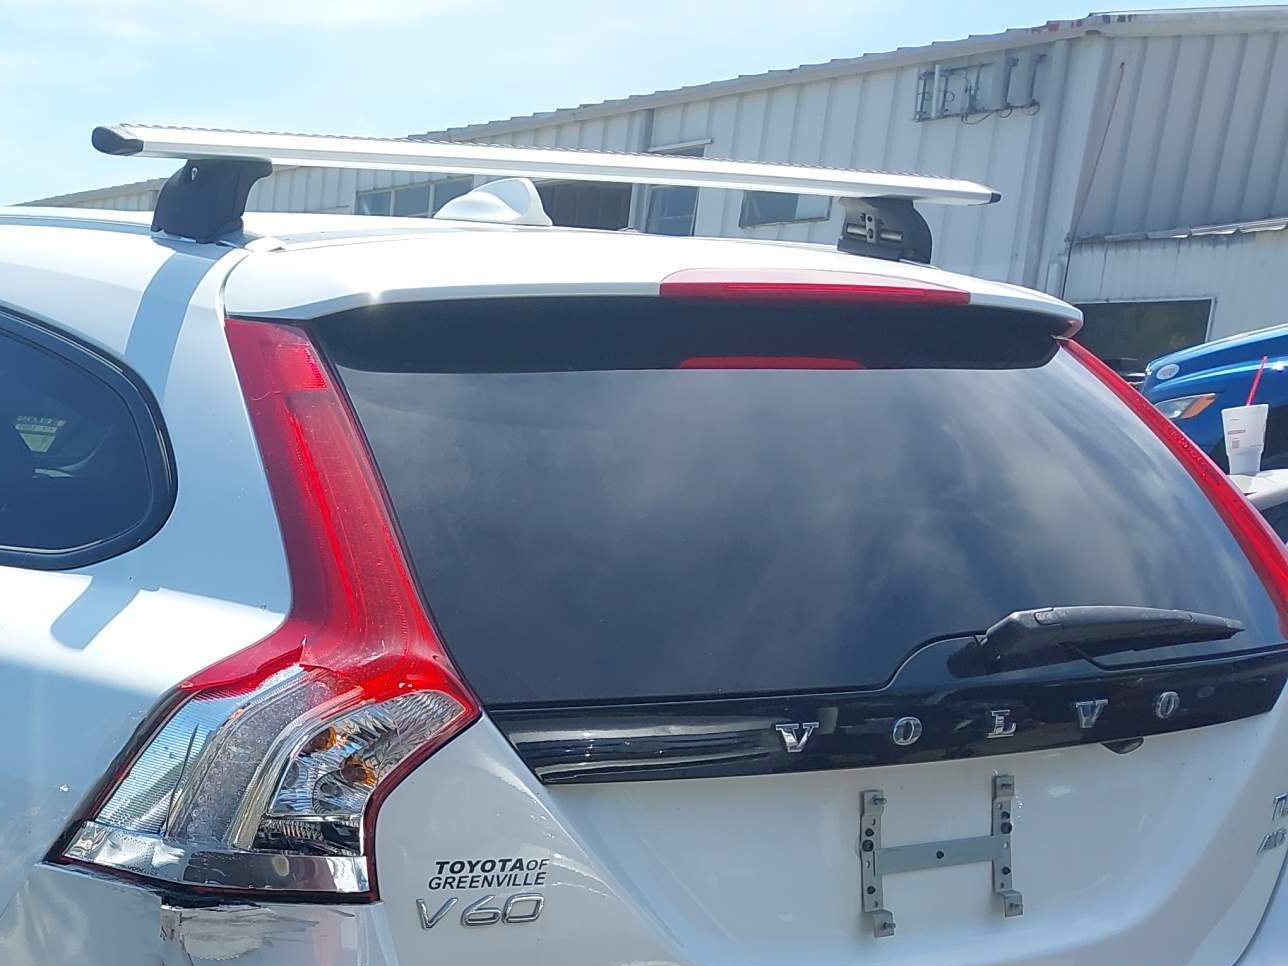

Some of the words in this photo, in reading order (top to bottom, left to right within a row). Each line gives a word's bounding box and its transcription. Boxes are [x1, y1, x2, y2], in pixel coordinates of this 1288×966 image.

[775, 691, 1180, 753] VOLVO
[435, 858, 524, 875] TOYOTA
[526, 859, 550, 871] OF
[428, 872, 546, 890] GREENVILLE
[416, 893, 545, 929] V60
